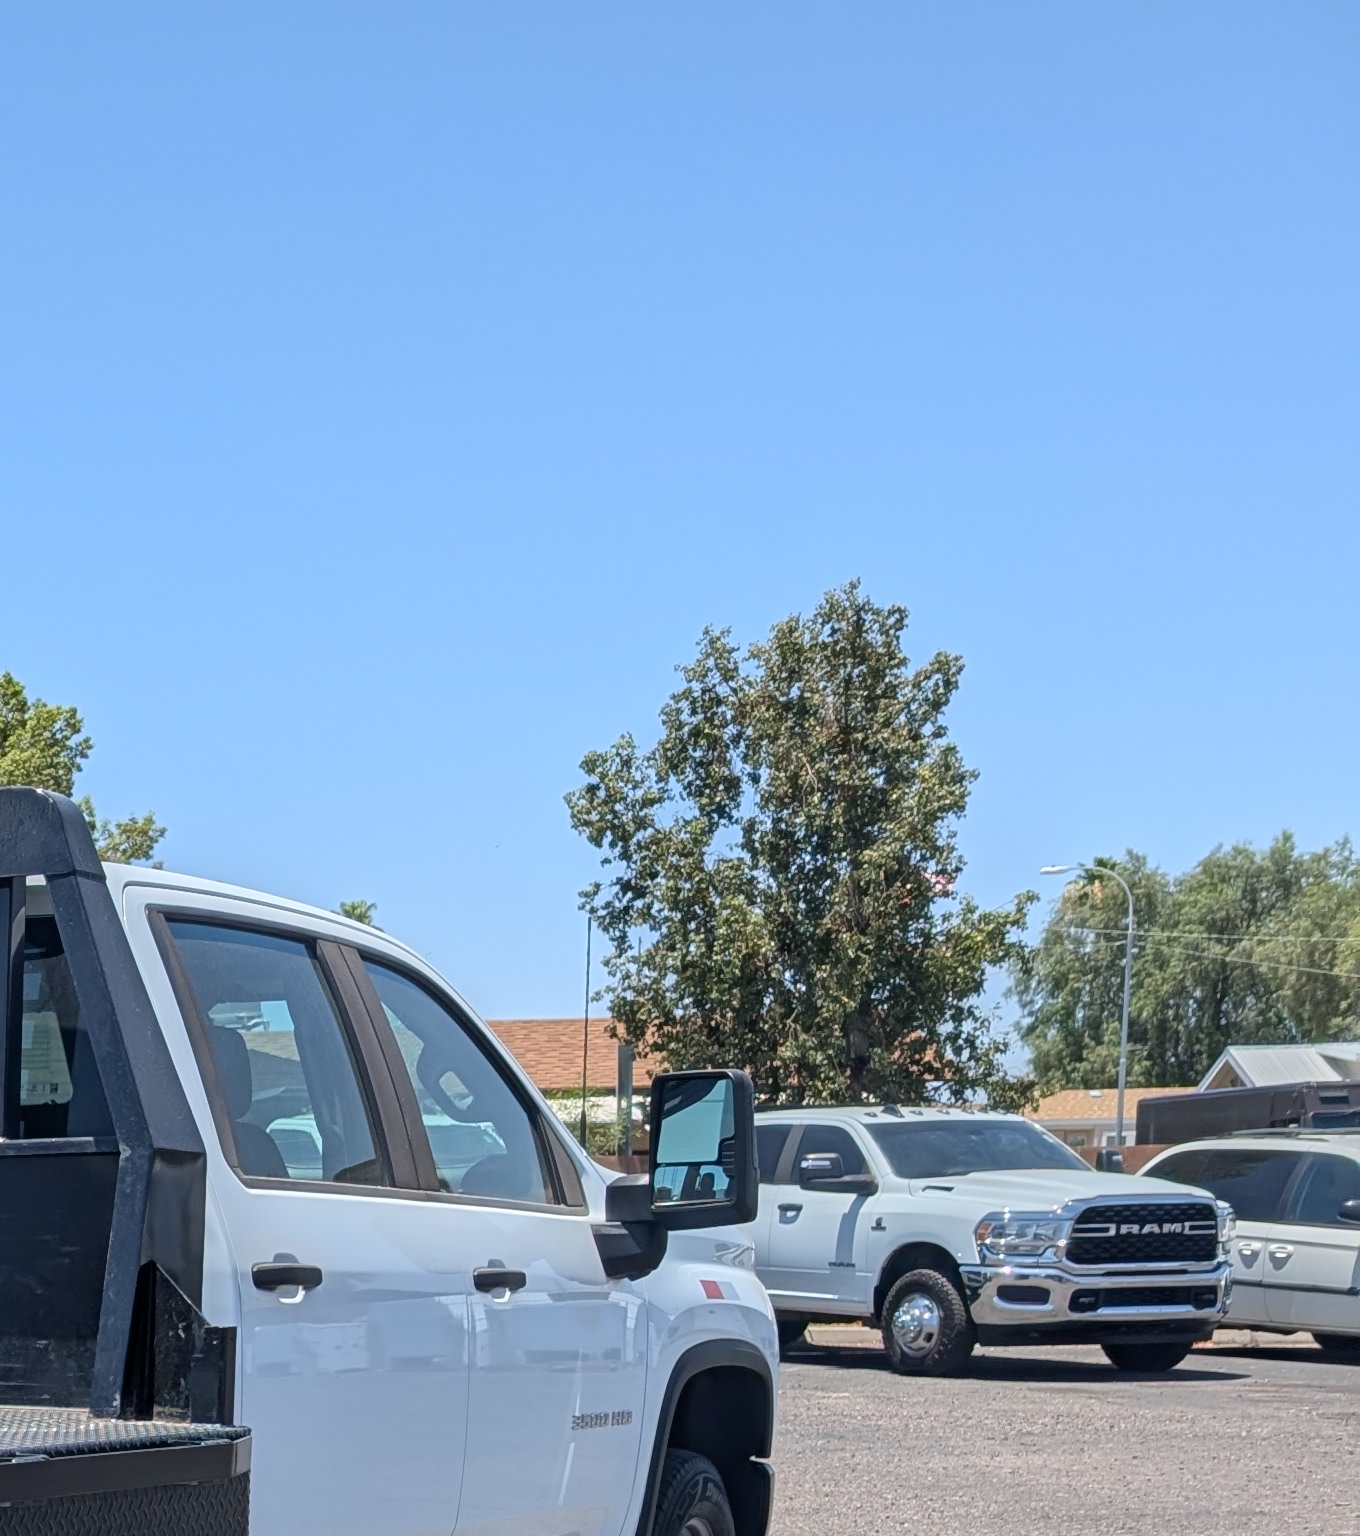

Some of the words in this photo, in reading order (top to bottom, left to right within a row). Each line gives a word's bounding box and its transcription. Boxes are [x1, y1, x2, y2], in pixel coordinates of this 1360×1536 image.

[1119, 1222, 1182, 1235] RAM
[571, 1411, 610, 1431] 3500
[611, 1409, 633, 1427] HD
